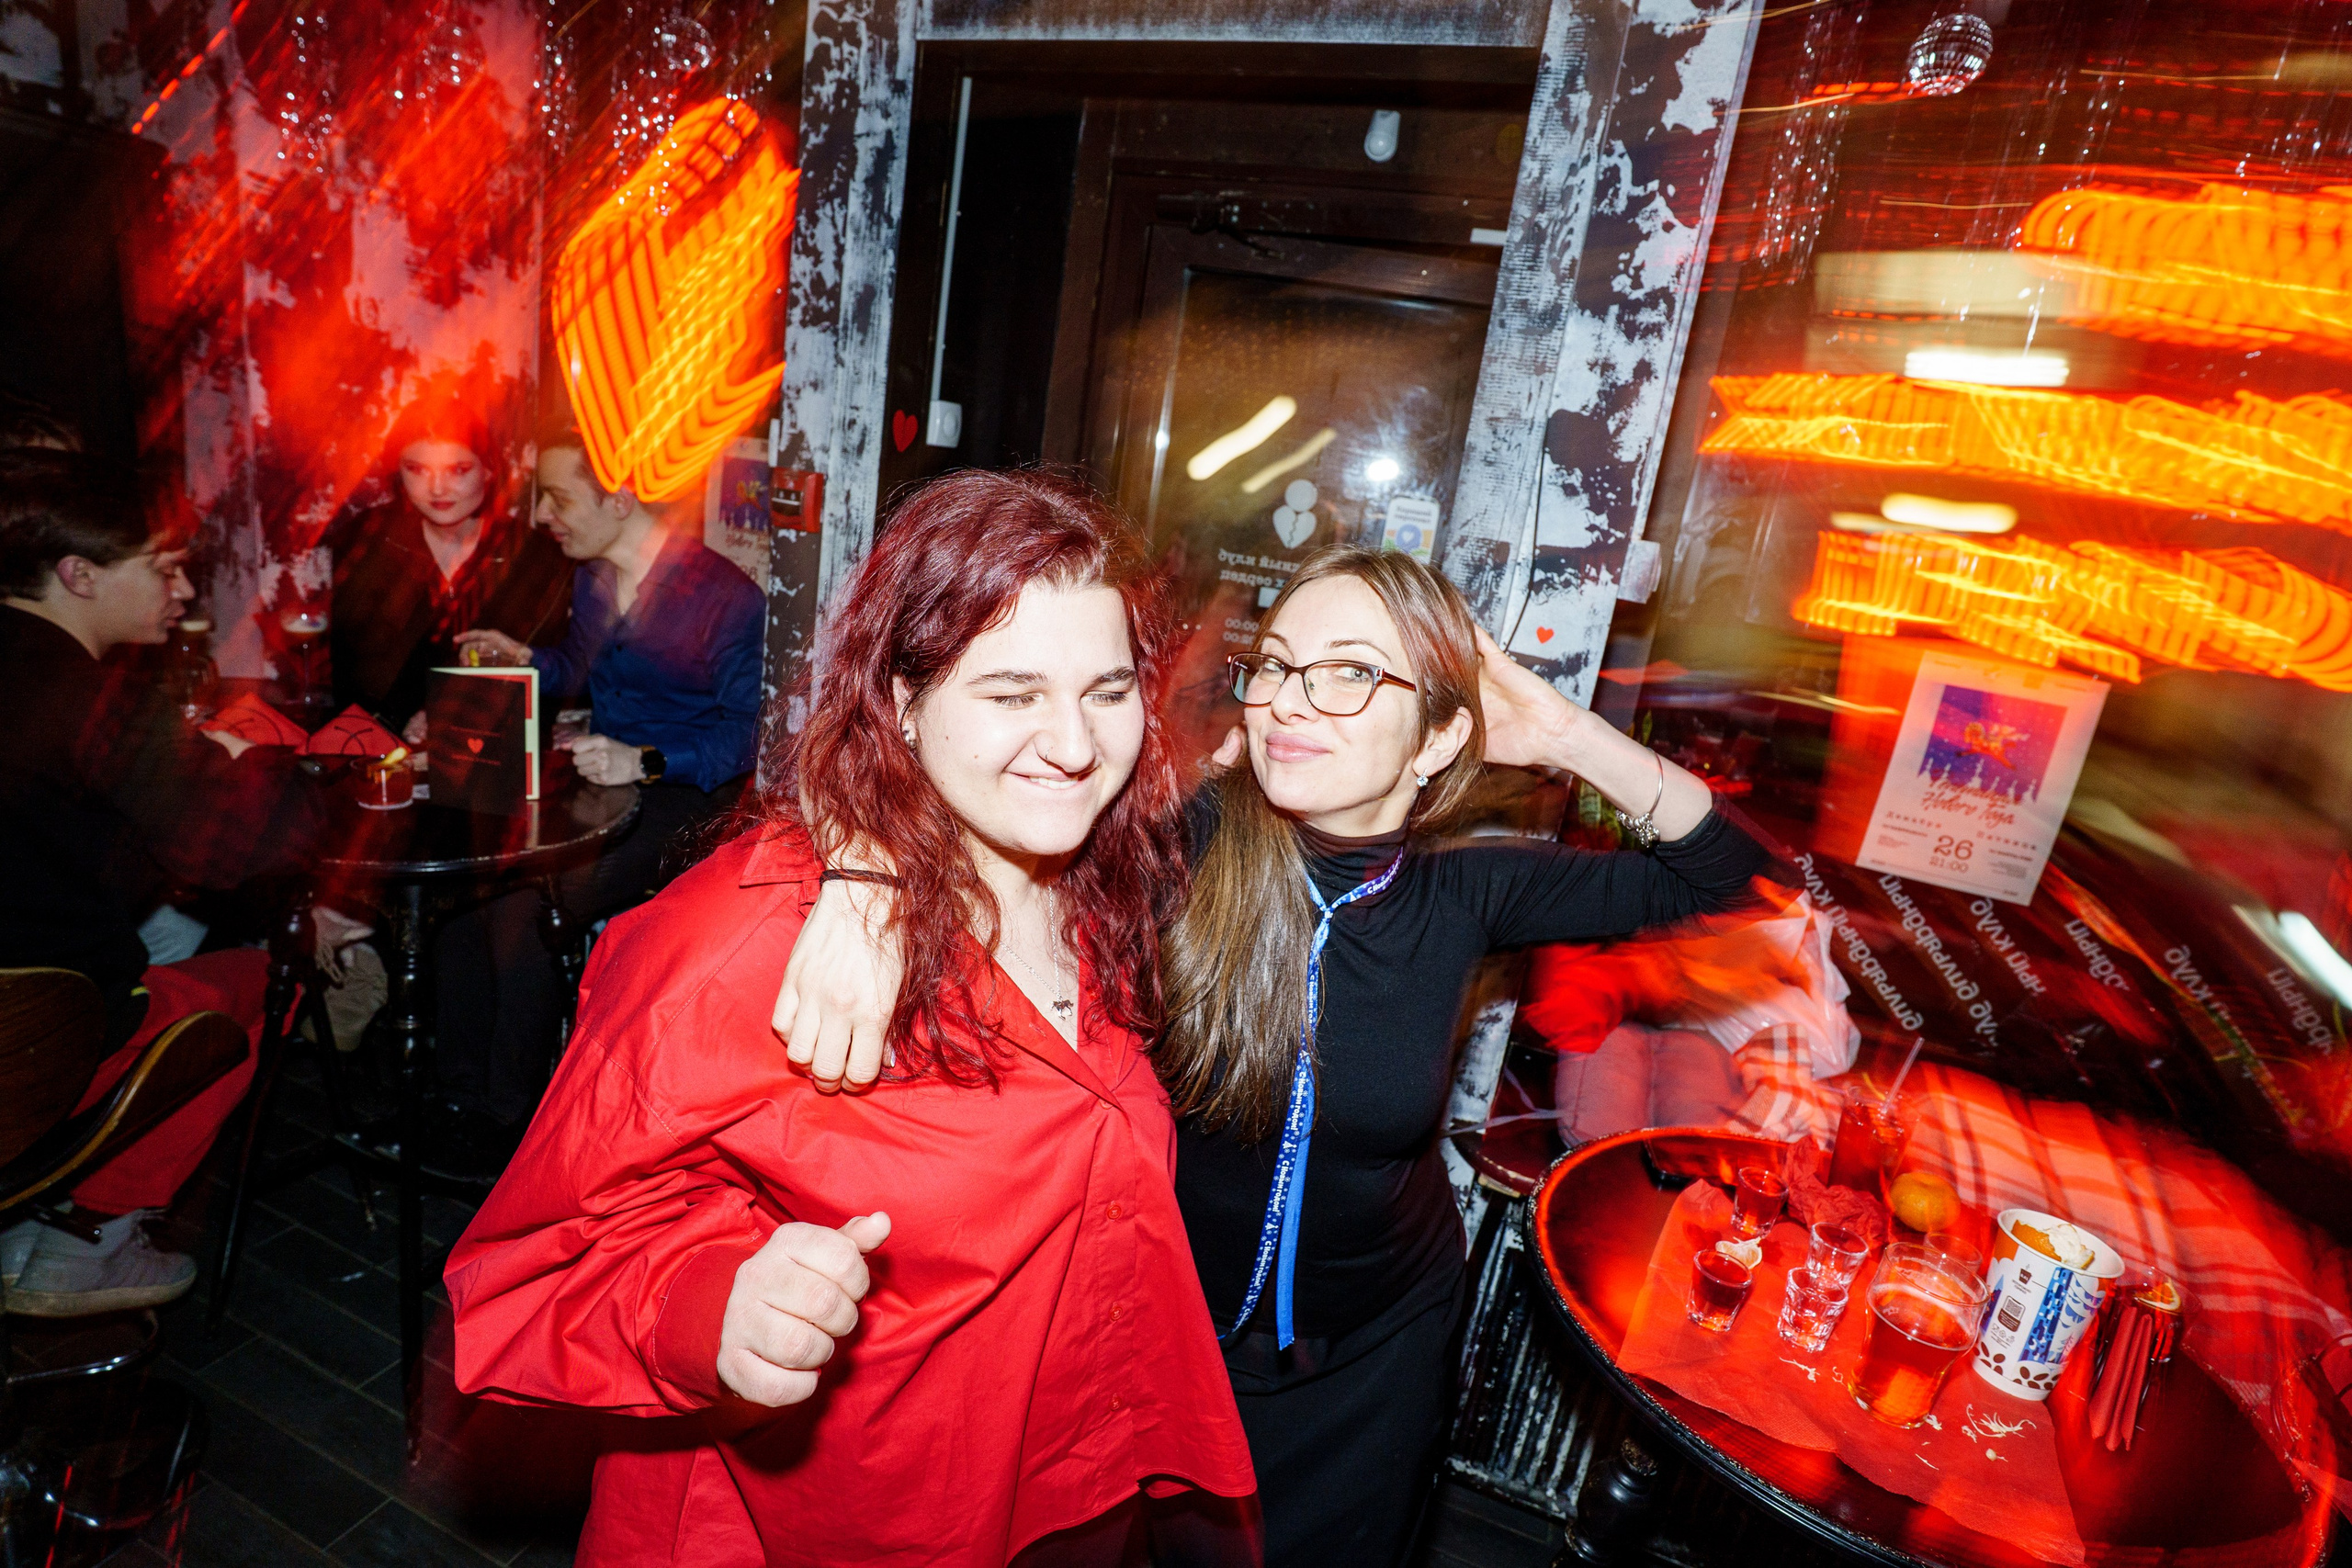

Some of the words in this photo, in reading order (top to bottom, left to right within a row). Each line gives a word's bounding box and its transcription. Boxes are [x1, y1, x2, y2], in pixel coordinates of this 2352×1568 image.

[1933, 835, 1973, 860] 26
[1295, 1078, 1306, 1104] Новым
[1291, 1105, 1301, 1131] годом!
[1277, 1166, 1289, 1189] Новым
[1272, 1189, 1283, 1213] годом!
